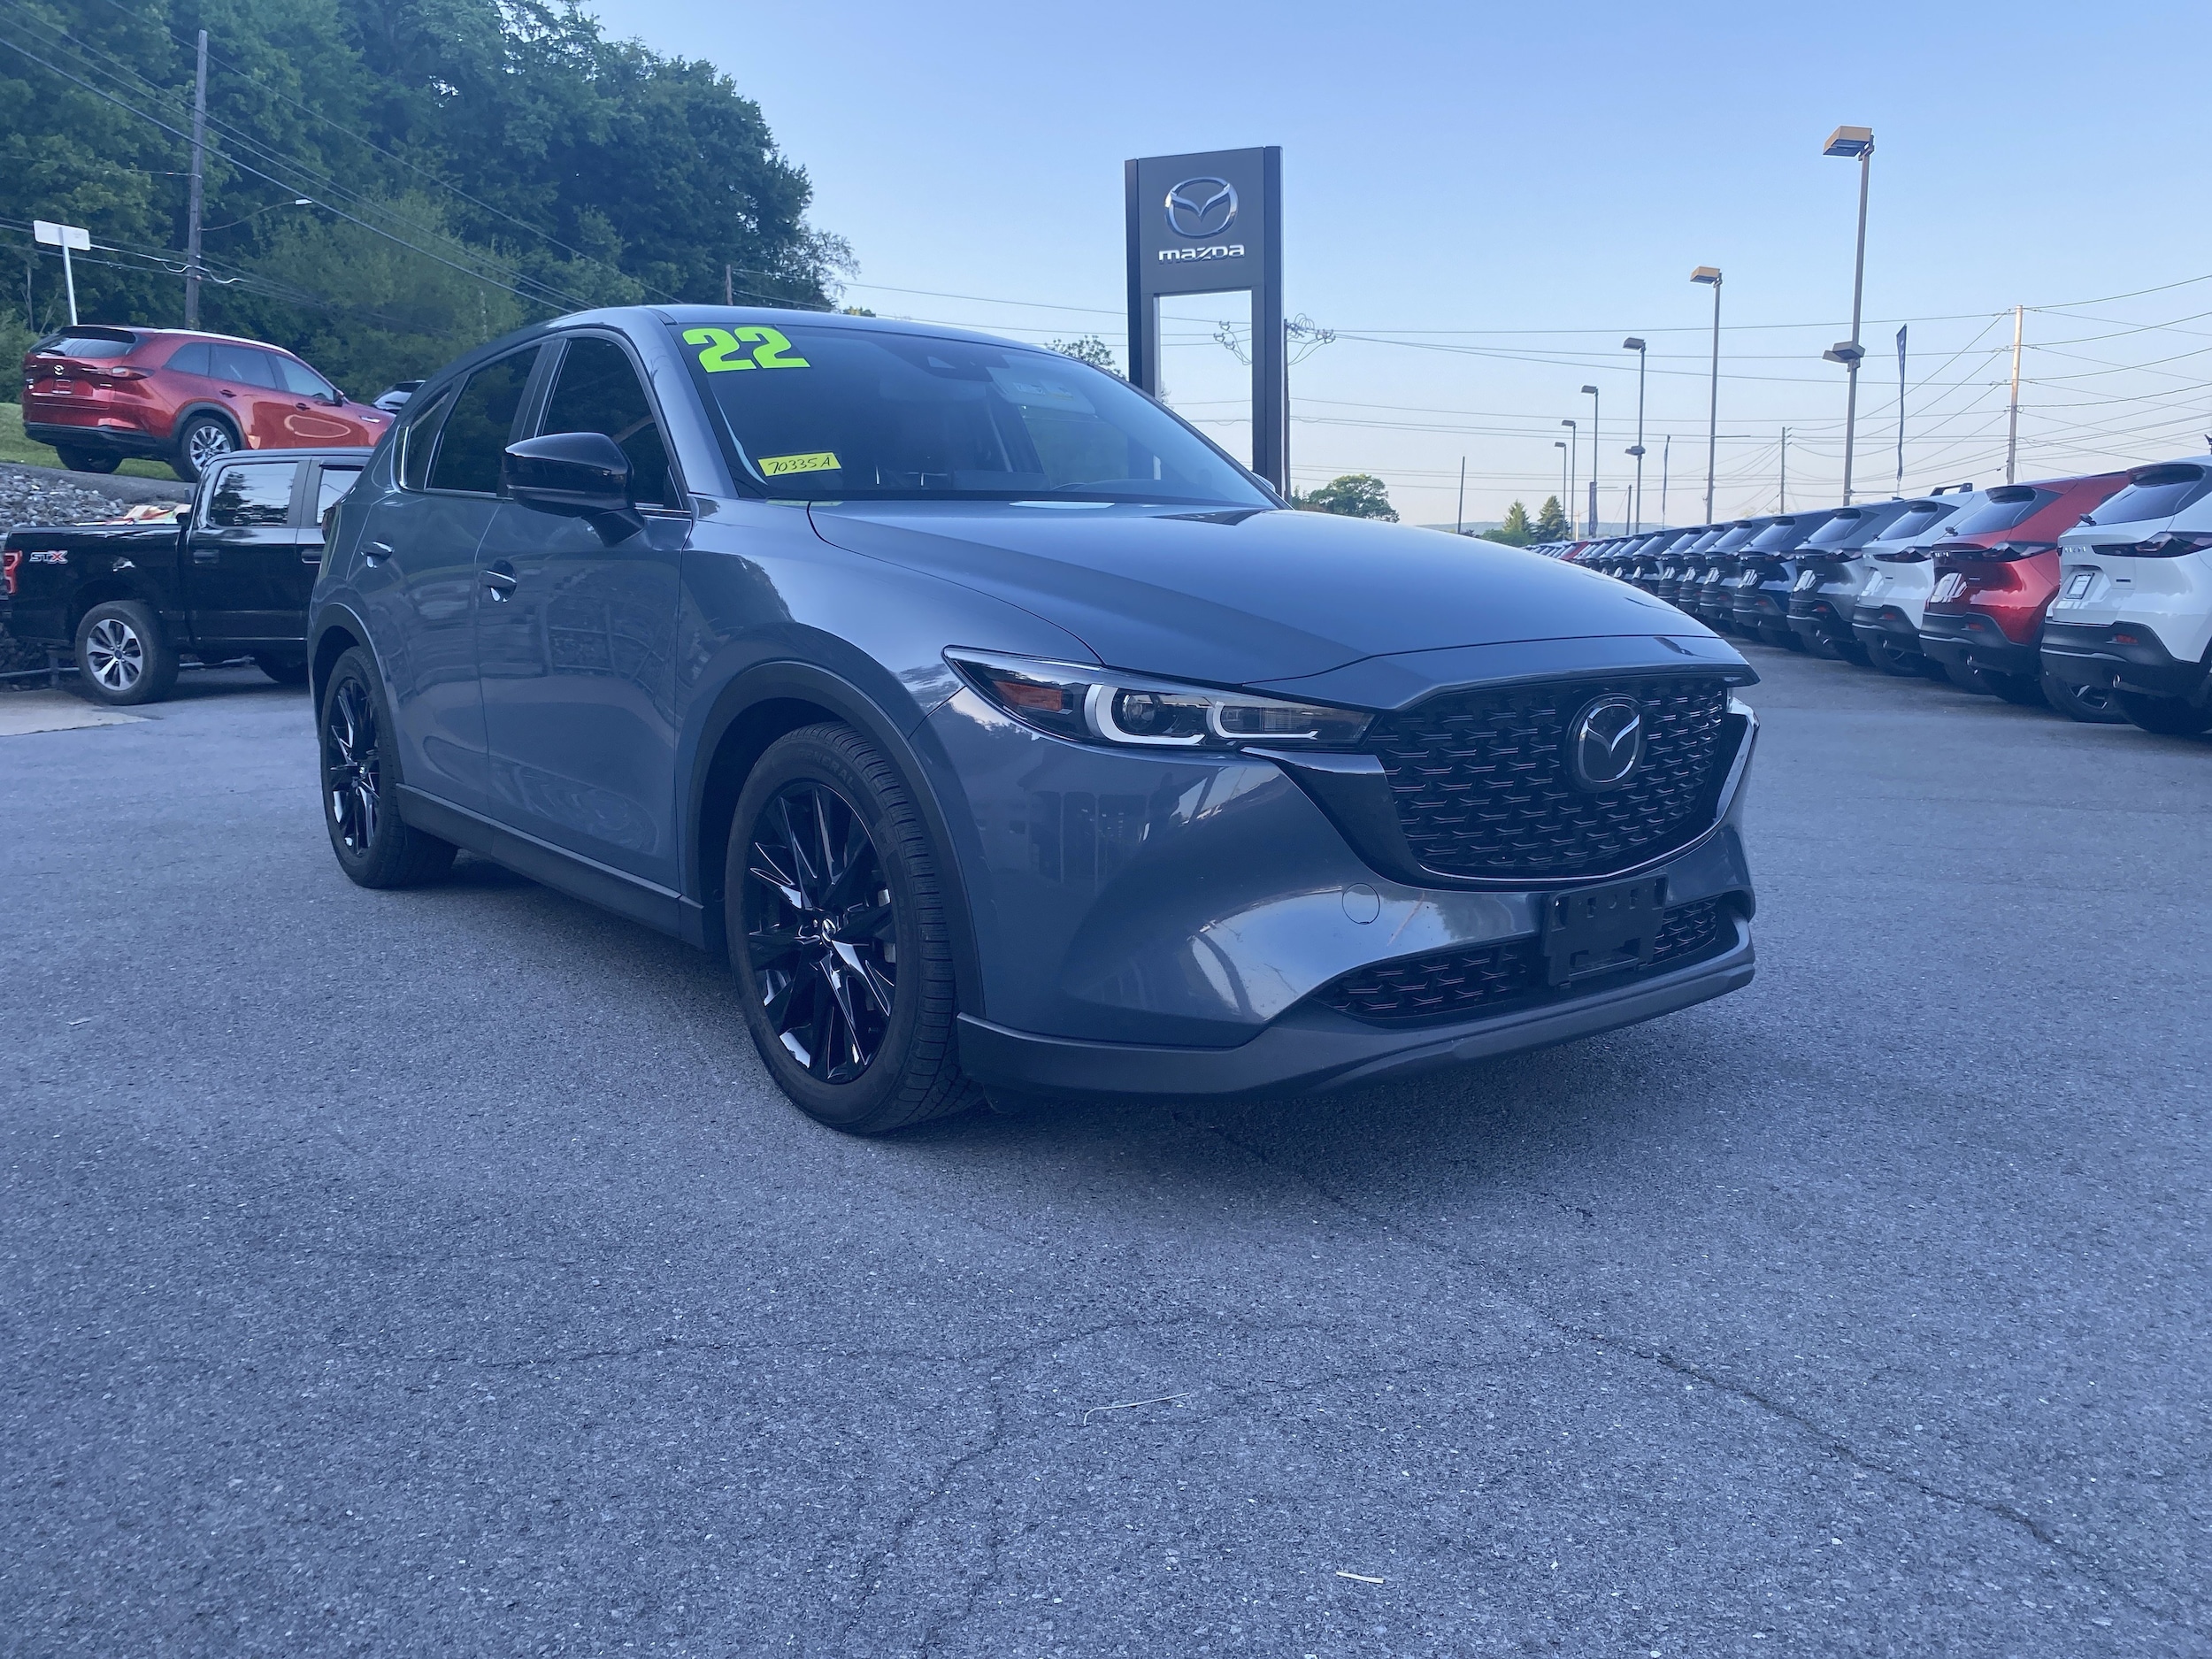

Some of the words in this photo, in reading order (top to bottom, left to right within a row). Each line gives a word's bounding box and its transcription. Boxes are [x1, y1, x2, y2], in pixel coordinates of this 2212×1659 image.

[1158, 243, 1245, 264] mazda
[682, 326, 810, 373] 22
[29, 550, 68, 564] STX
